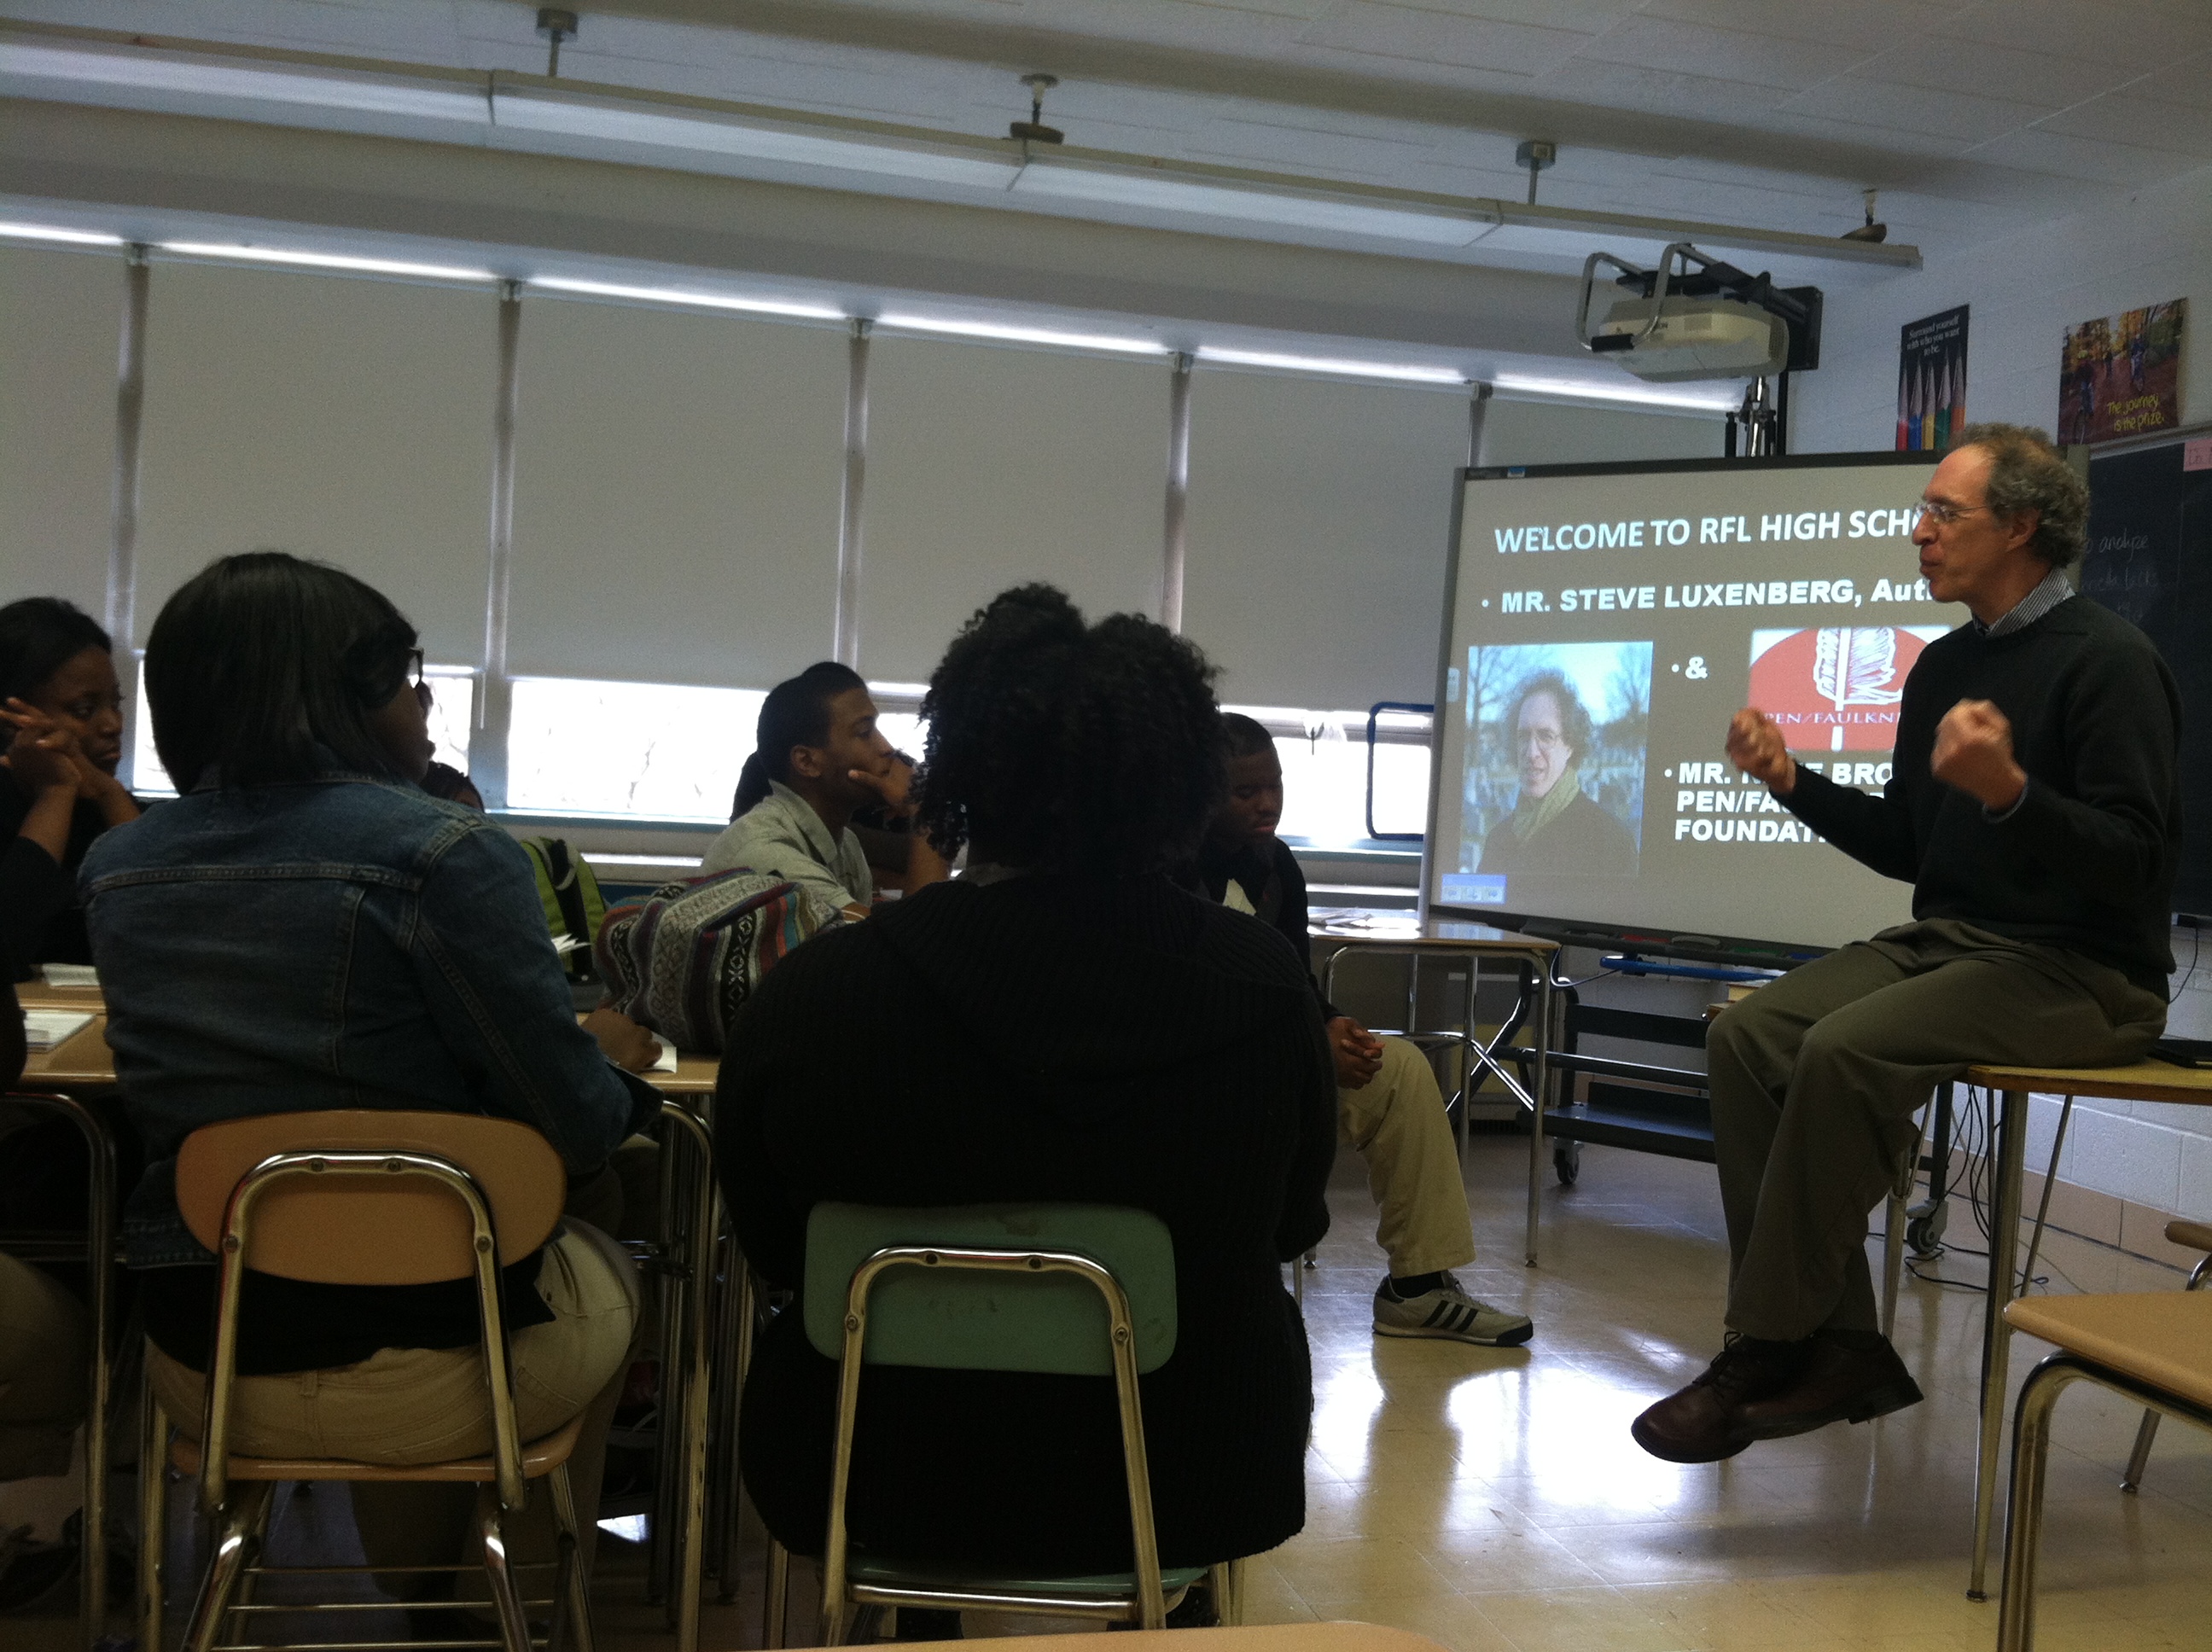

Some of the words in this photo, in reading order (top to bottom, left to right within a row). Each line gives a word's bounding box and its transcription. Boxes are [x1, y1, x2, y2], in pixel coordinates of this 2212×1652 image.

[2107, 400, 2122, 416] The
[2123, 393, 2159, 416] journey
[2123, 416, 2136, 431] the
[1494, 521, 1644, 554] WELCOME
[1650, 518, 1691, 546] TO
[1700, 515, 1752, 544] RFL
[1761, 511, 1841, 542] HIGH
[1502, 590, 1551, 614] MR.
[1559, 586, 1656, 612] STEVE
[1664, 578, 1862, 608] LUXENBERG,
[1685, 656, 1708, 679] &
[1679, 762, 1732, 784] MR.
[1675, 818, 1826, 843] FOUNDAT
